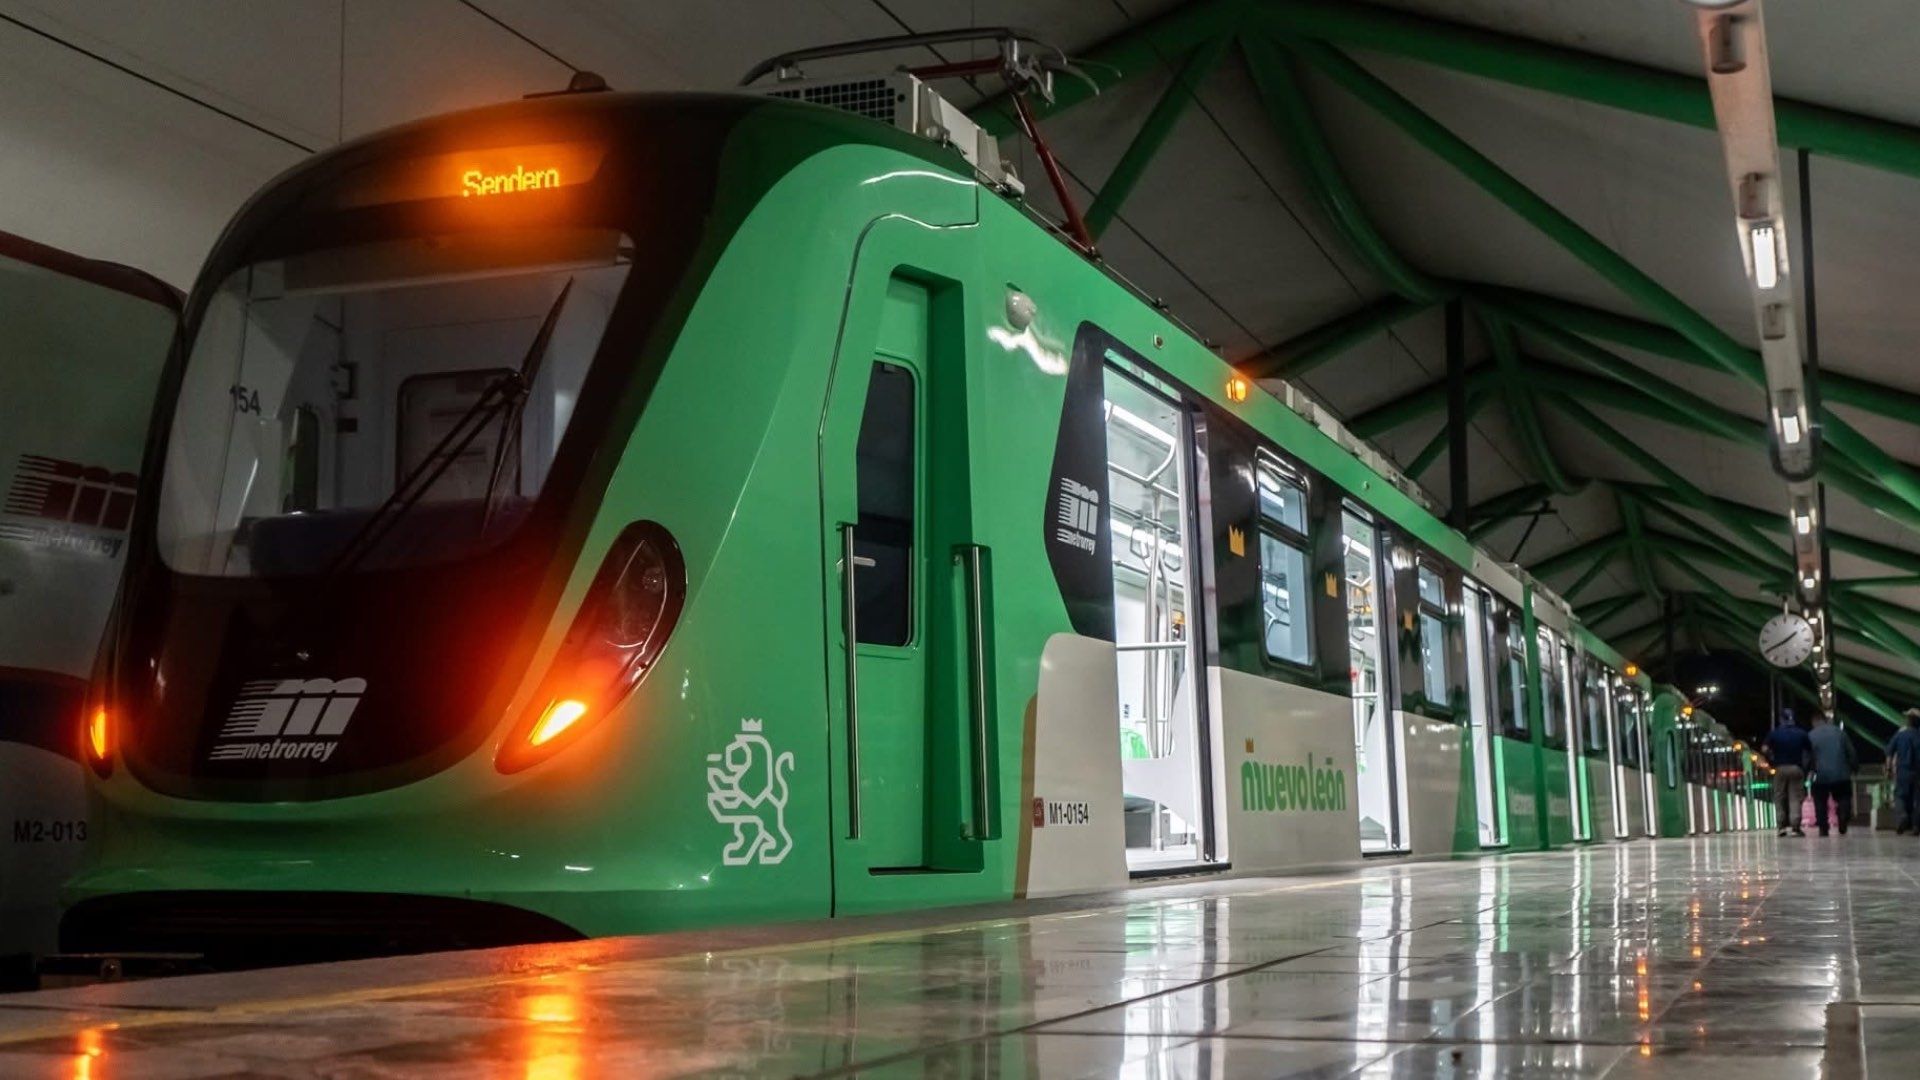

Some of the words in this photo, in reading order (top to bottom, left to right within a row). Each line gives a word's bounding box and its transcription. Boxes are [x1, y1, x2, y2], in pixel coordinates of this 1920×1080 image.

[229, 385, 262, 416] 154
[220, 738, 338, 763] metrorrey
[1049, 802, 1089, 824] M1-0154
[14, 821, 87, 842] M2-013
